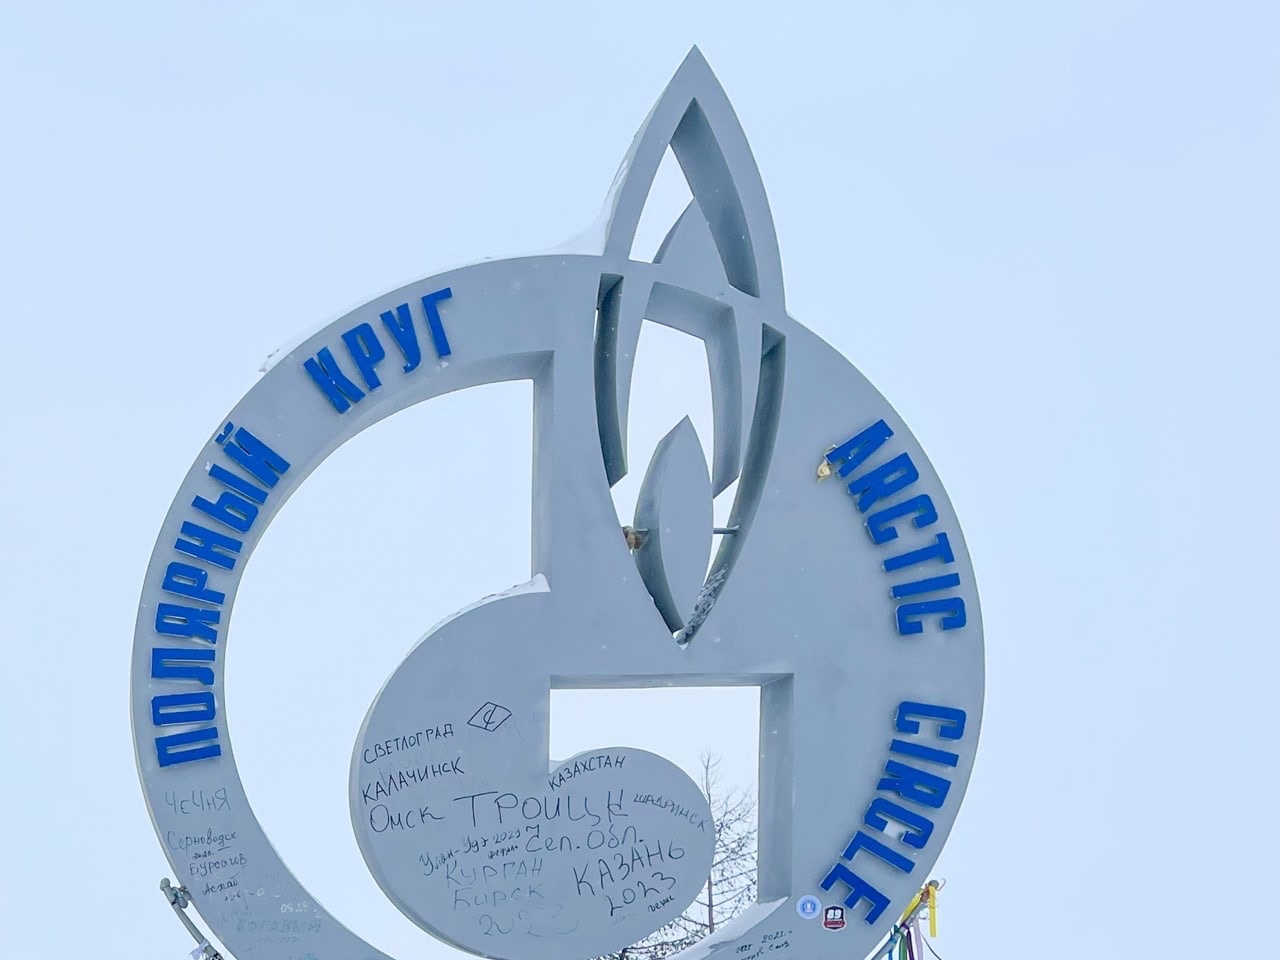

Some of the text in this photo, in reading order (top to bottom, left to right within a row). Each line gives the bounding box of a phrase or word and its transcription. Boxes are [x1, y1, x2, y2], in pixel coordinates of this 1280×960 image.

[150, 420, 291, 769] ПОЛЯРНЫЙ
[302, 286, 453, 415] КРУГ
[819, 418, 968, 926] ARCTIC CIRCLE
[362, 722, 455, 765] СВЕТЛОГРАД
[361, 756, 466, 806] КАЛАЧИНСК
[547, 755, 627, 792] КАЗАХСТАН
[573, 839, 686, 897] КАЗАНЬ
[604, 871, 677, 918] 2023
